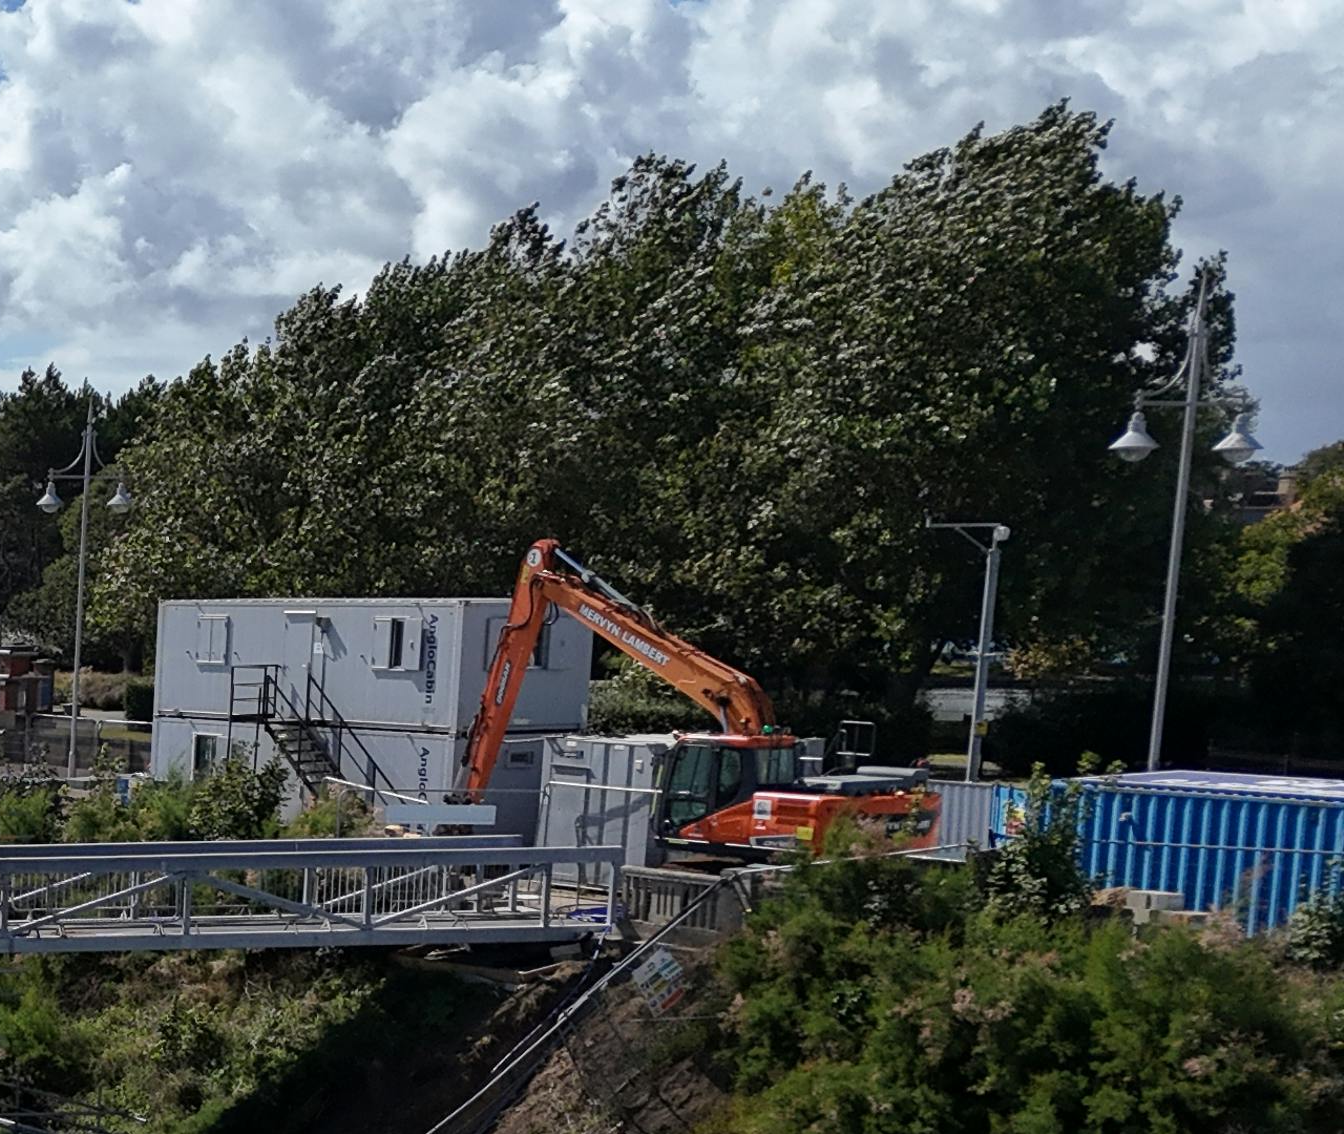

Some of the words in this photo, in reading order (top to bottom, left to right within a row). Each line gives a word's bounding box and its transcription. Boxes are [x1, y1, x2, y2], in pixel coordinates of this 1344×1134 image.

[424, 614, 439, 704] AngloCabin
[578, 604, 621, 636] MERVYN
[621, 630, 671, 666] LAMBERT
[417, 746, 430, 803] AngloC
